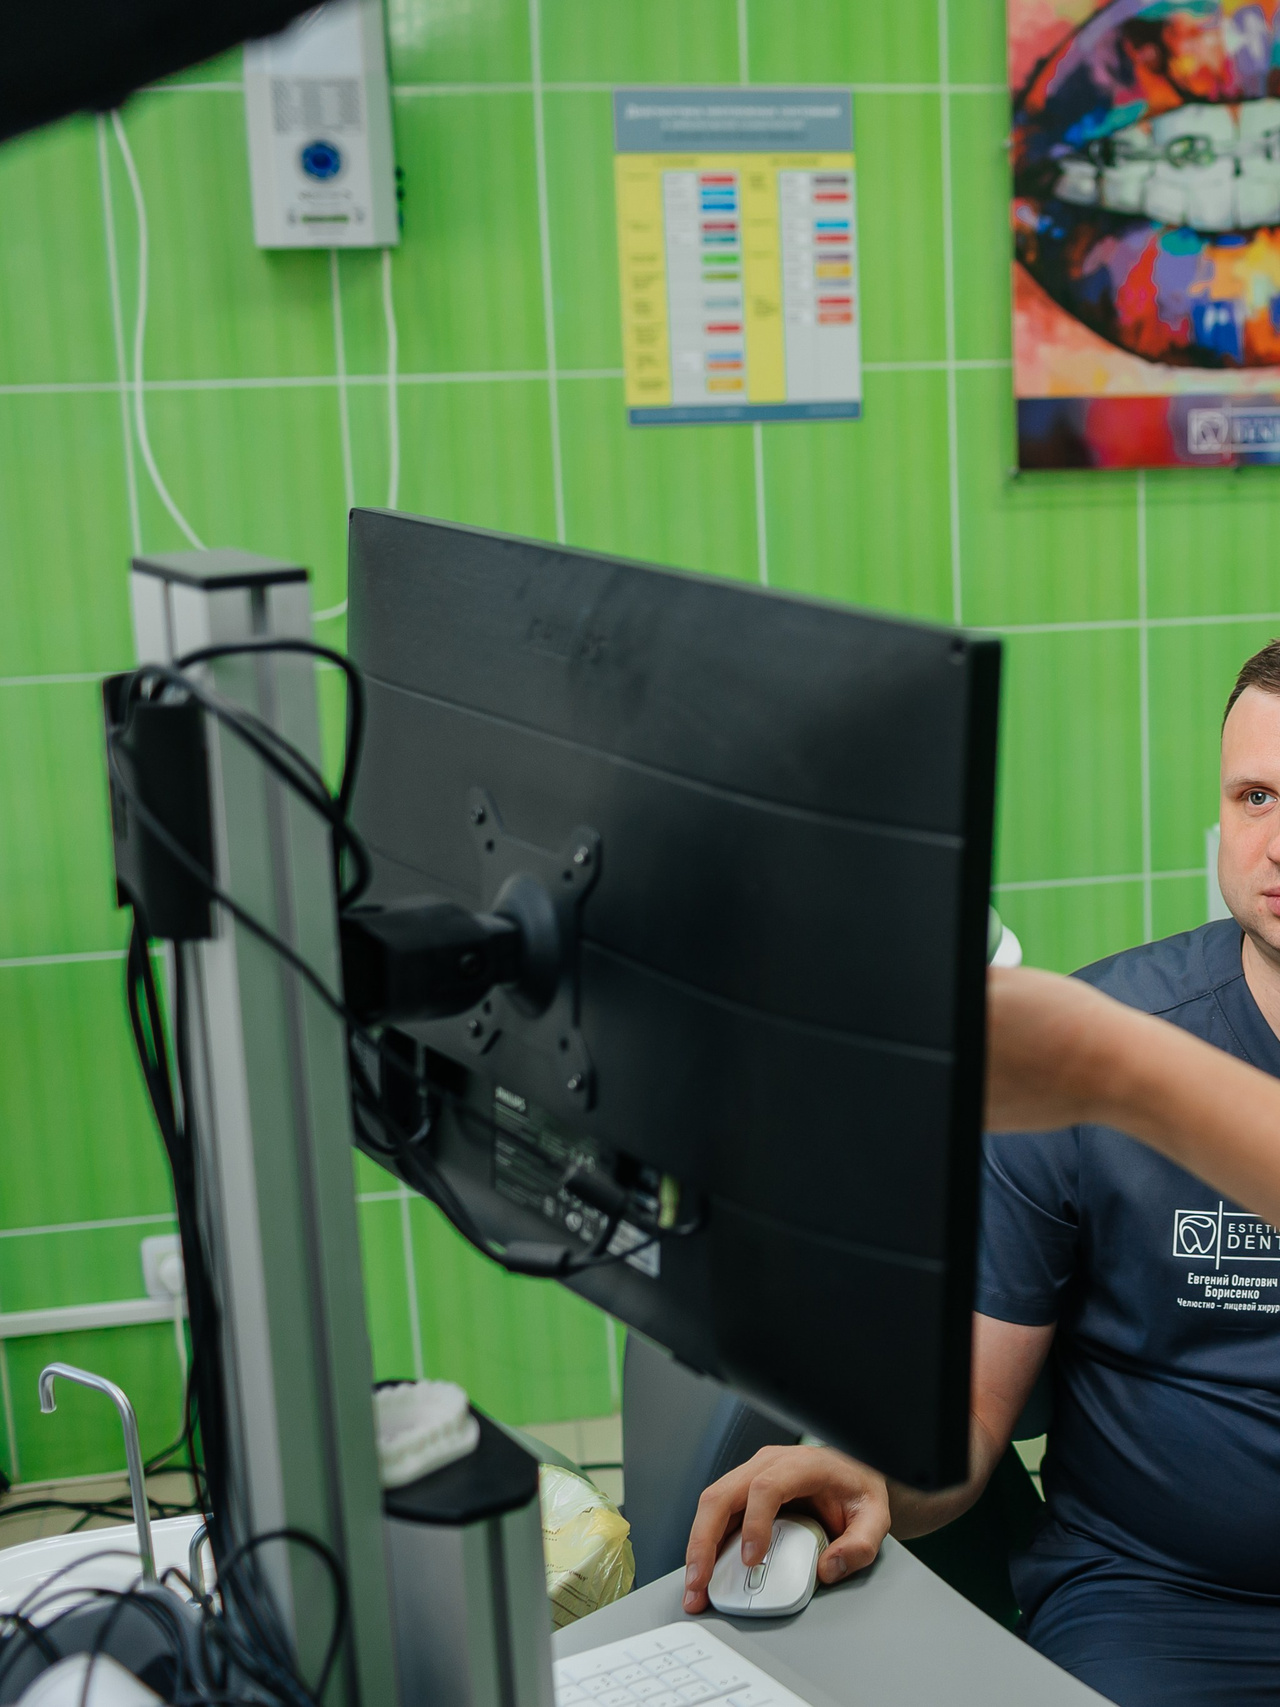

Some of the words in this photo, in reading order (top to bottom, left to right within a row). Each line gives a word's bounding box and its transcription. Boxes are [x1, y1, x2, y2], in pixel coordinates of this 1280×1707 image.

[1187, 1272, 1229, 1286] Евгений
[1231, 1274, 1278, 1287] Олегович
[1204, 1285, 1260, 1300] Борисенко
[1177, 1297, 1215, 1309] Челюстно
[1223, 1302, 1256, 1311] лицевой
